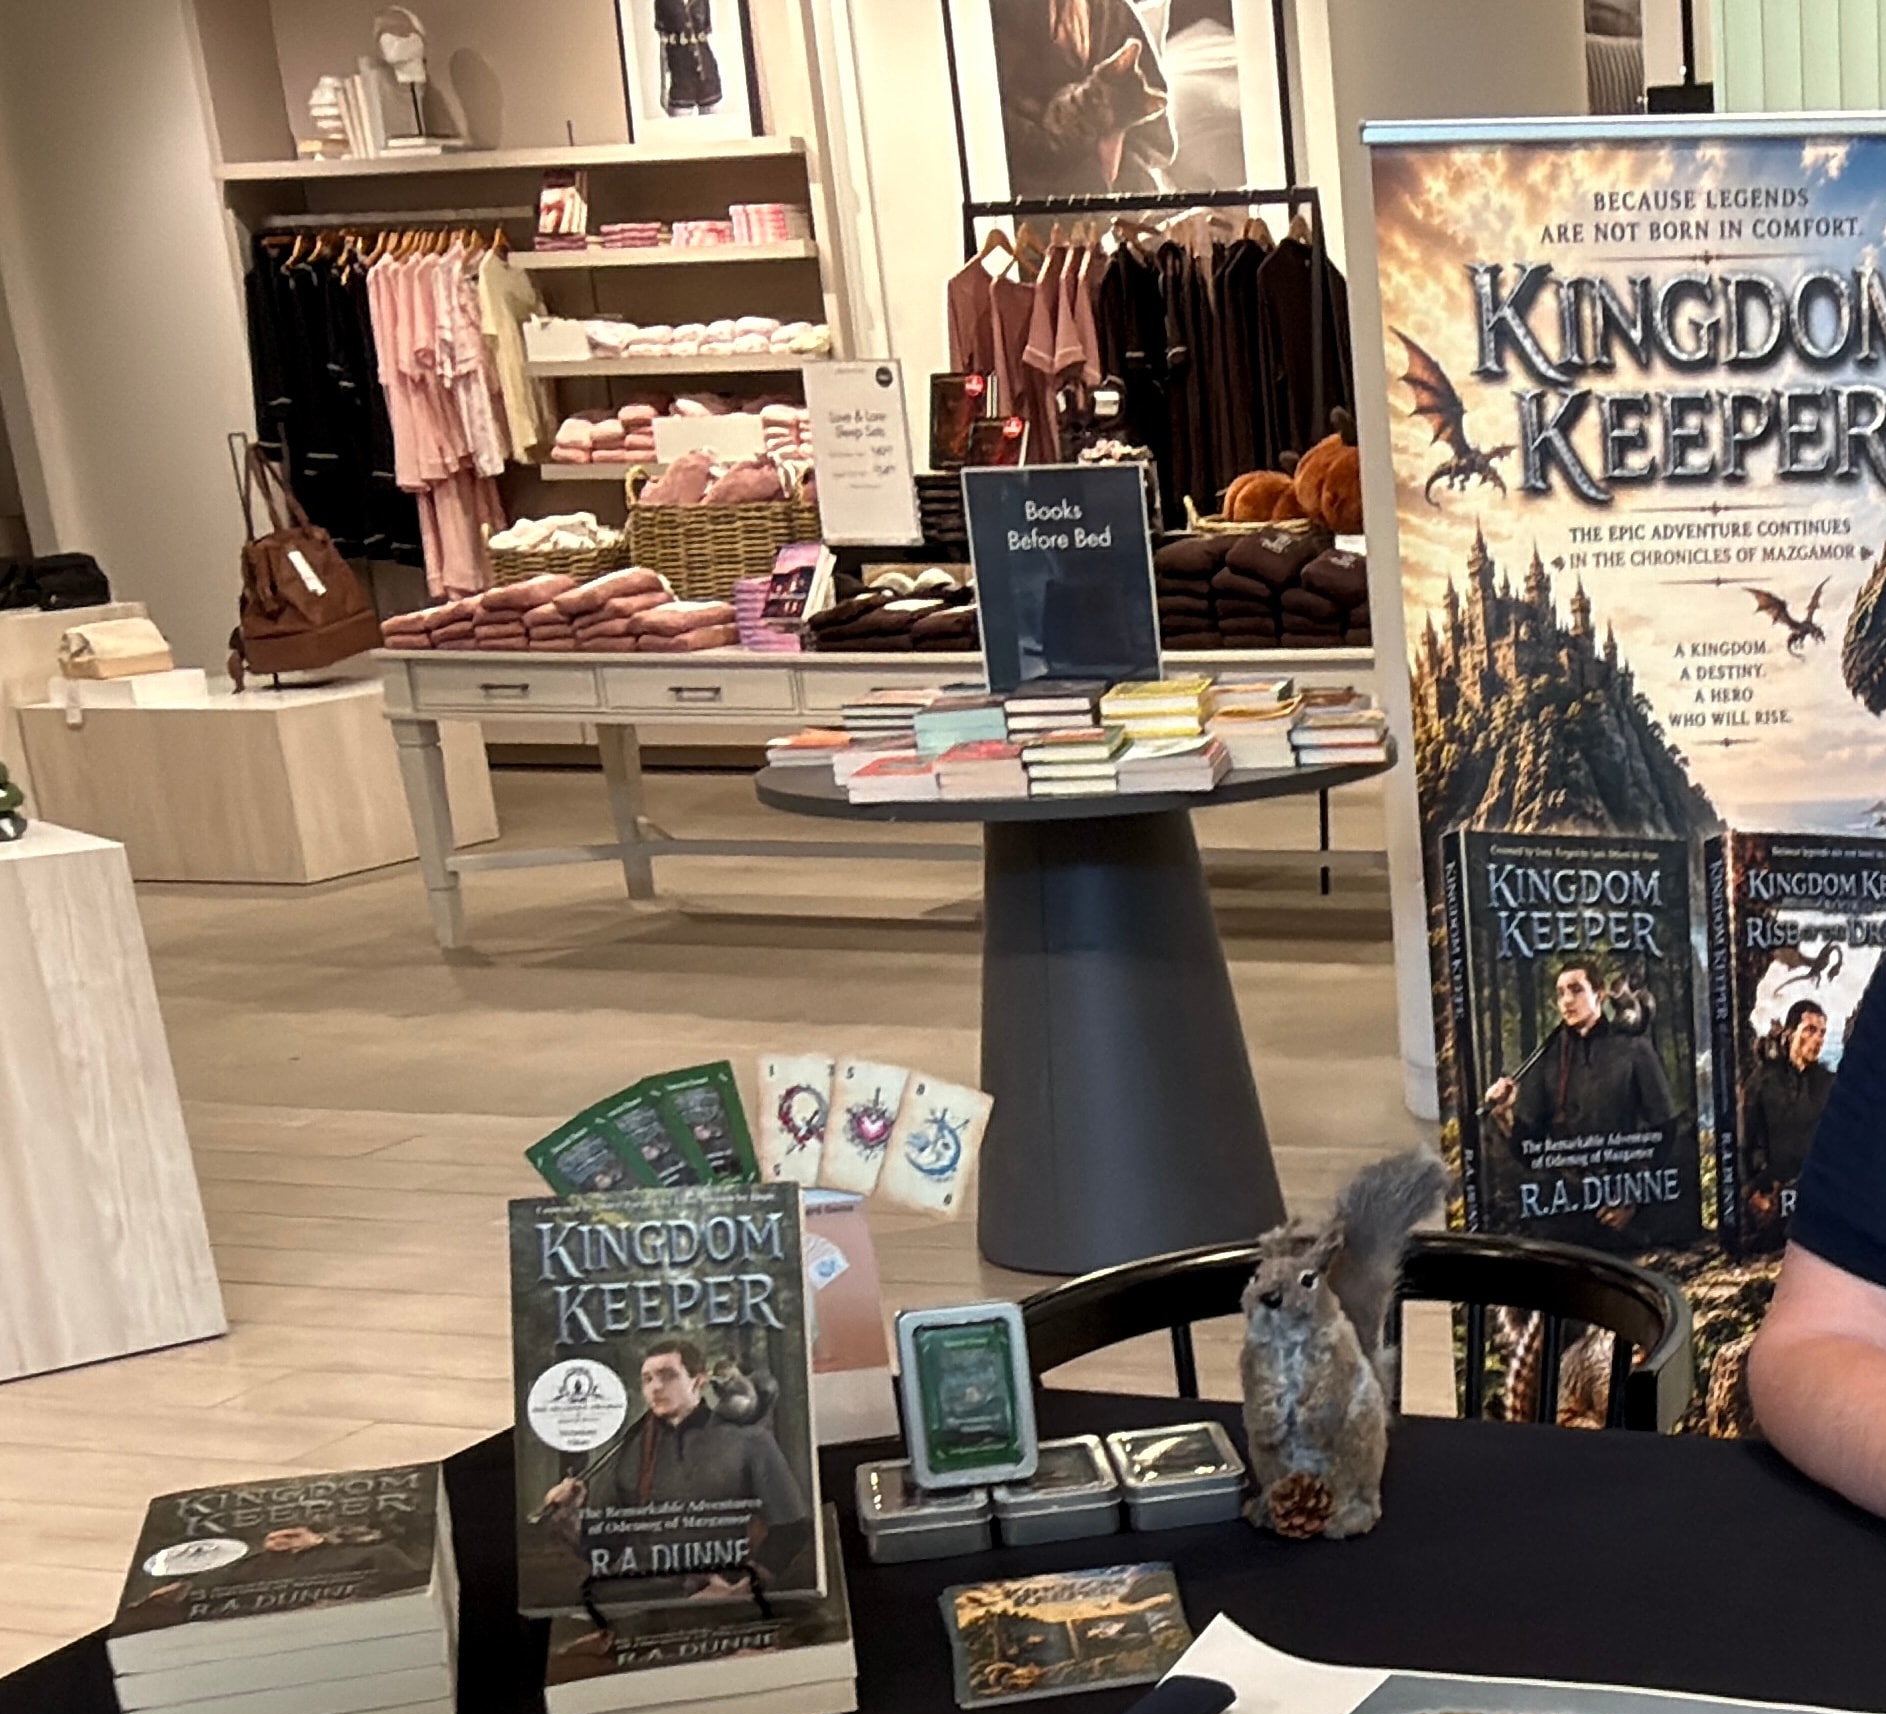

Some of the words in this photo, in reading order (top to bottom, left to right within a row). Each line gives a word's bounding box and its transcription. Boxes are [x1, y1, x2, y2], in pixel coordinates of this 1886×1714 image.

[1593, 190, 1696, 212] BECAUSE
[1706, 187, 1810, 210] LEGENDS
[1540, 222, 1584, 244] ARE
[1594, 221, 1638, 243] NOT
[1650, 219, 1709, 241] BORN
[1719, 218, 1743, 239] IN
[1752, 215, 1864, 238] COMFORT.
[1024, 499, 1083, 521] Books
[1008, 526, 1069, 550] Before
[1074, 526, 1111, 549] Bed
[1569, 526, 1603, 543] THE
[1608, 525, 1646, 542] EPIC
[1651, 521, 1752, 540] ADVENTURE
[1757, 518, 1851, 537] CONTINUES
[1570, 552, 1587, 569] IN
[1592, 551, 1625, 568] THE
[1631, 547, 1731, 567] CHRONICLES
[1736, 546, 1757, 563] OF
[1762, 544, 1855, 563] MAZGAMOR
[1674, 643, 1685, 658] A
[1680, 666, 1691, 681] A
[1694, 689, 1705, 704] A
[1711, 687, 1754, 703] HERO
[1669, 712, 1706, 728] WHO
[1711, 710, 1750, 726] WILL
[1486, 863, 1663, 908] KINGDOM
[1749, 869, 1857, 900] KINGDOM
[1497, 911, 1664, 958] KEEPER
[1746, 915, 1799, 950] RISE
[1521, 1139, 1543, 1154] The
[1520, 1181, 1579, 1219] R.A.
[1583, 1169, 1681, 1210] DUNNE
[1780, 1189, 1798, 1218] R
[534, 1211, 785, 1281] KINGDOM
[552, 1273, 785, 1345] KEEPER
[177, 1472, 420, 1520] KINGDOM
[186, 1494, 419, 1536] KEEPER
[578, 1507, 602, 1520] The
[605, 1500, 685, 1518] Remarkable
[688, 1498, 763, 1513] Adventures
[588, 1521, 604, 1535] of
[664, 1516, 679, 1529] of
